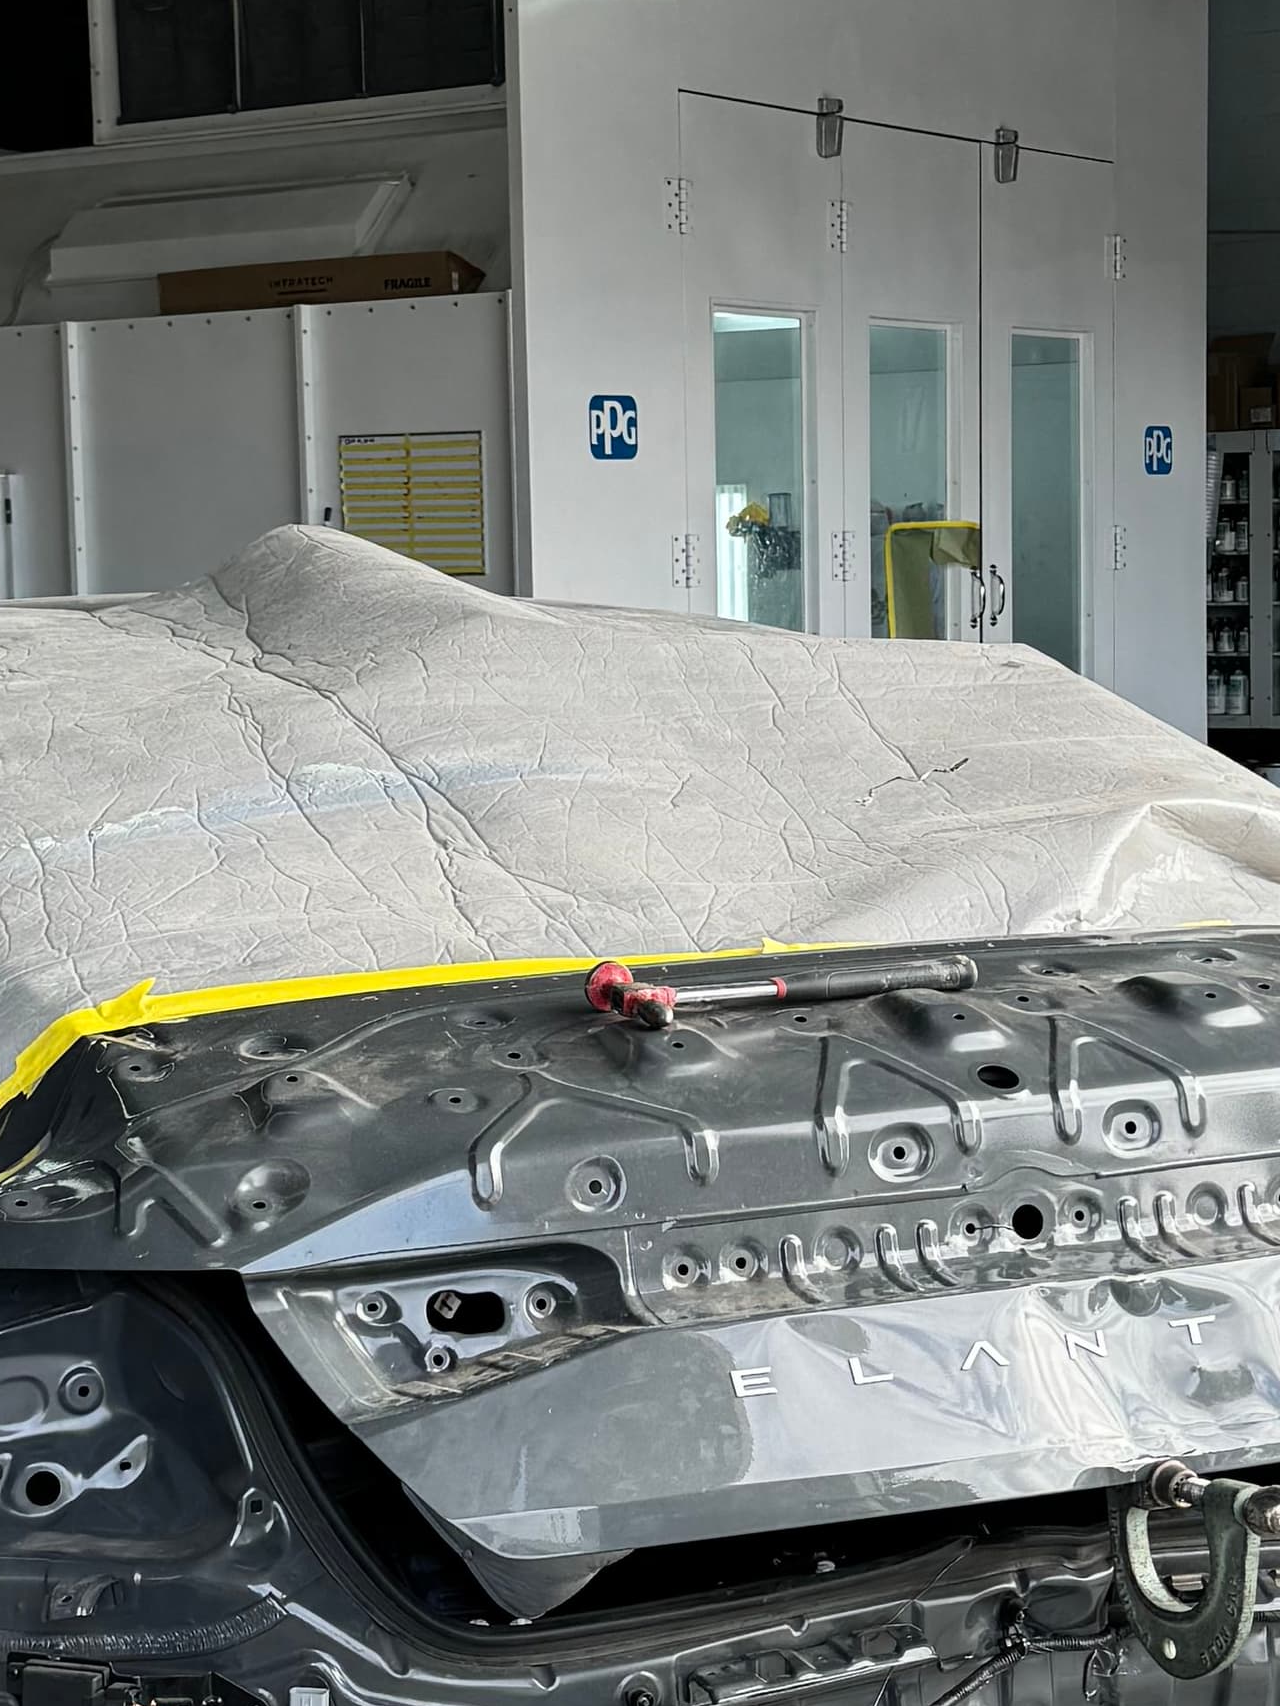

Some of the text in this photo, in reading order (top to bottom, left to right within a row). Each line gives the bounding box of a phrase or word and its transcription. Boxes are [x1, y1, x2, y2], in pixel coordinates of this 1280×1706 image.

[269, 276, 431, 291] INFRATECH FRAGILE
[590, 400, 637, 455] PPG
[1145, 429, 1171, 472] PPG
